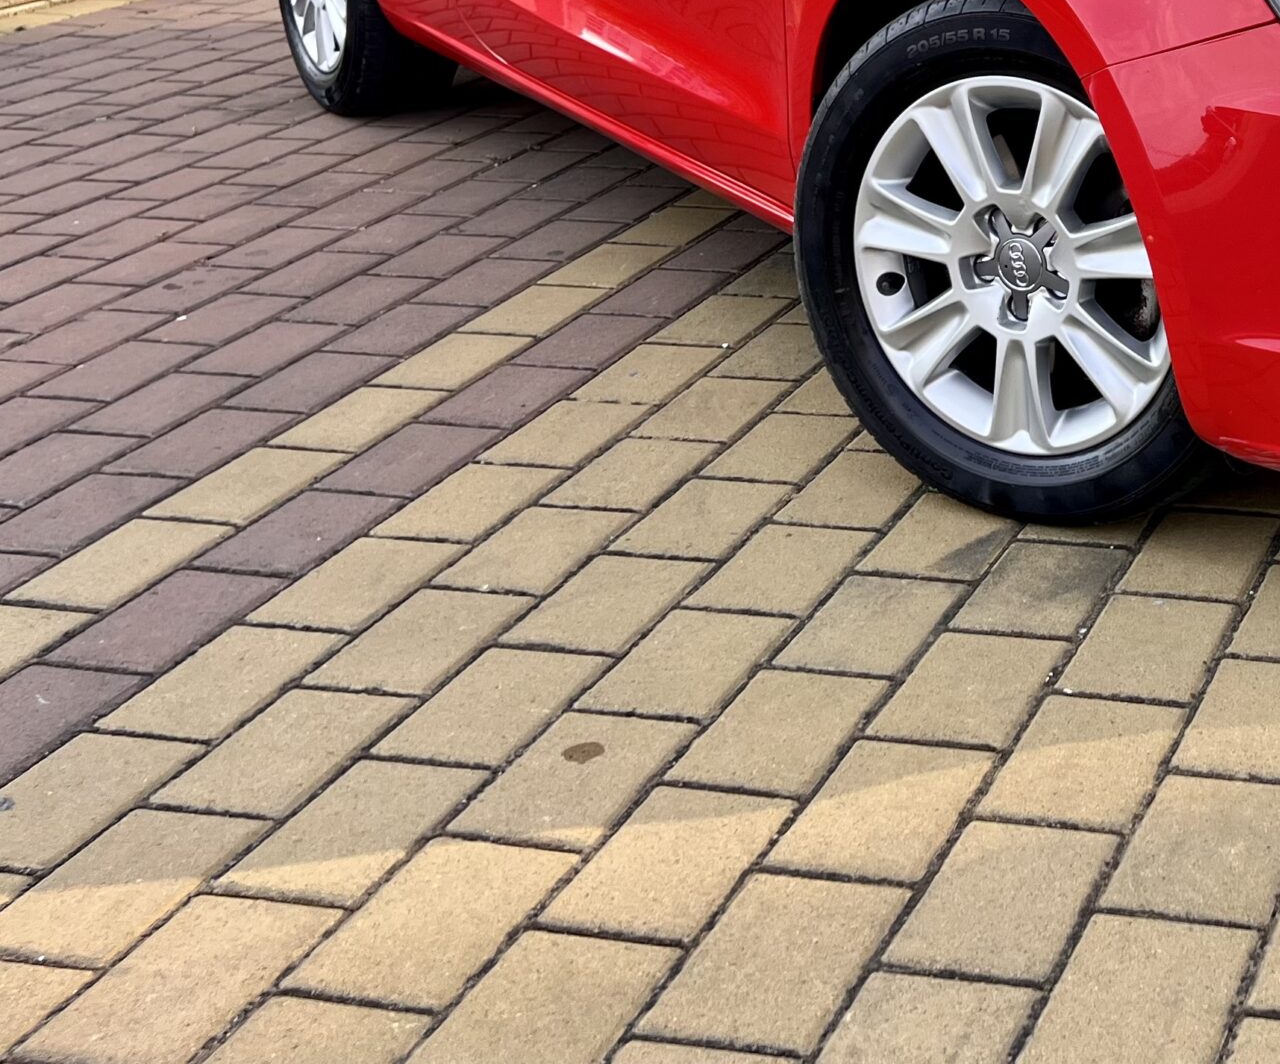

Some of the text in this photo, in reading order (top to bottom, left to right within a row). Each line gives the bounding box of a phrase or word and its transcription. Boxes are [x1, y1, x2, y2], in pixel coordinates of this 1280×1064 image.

[906, 27, 1011, 59] 205/55 R 15
